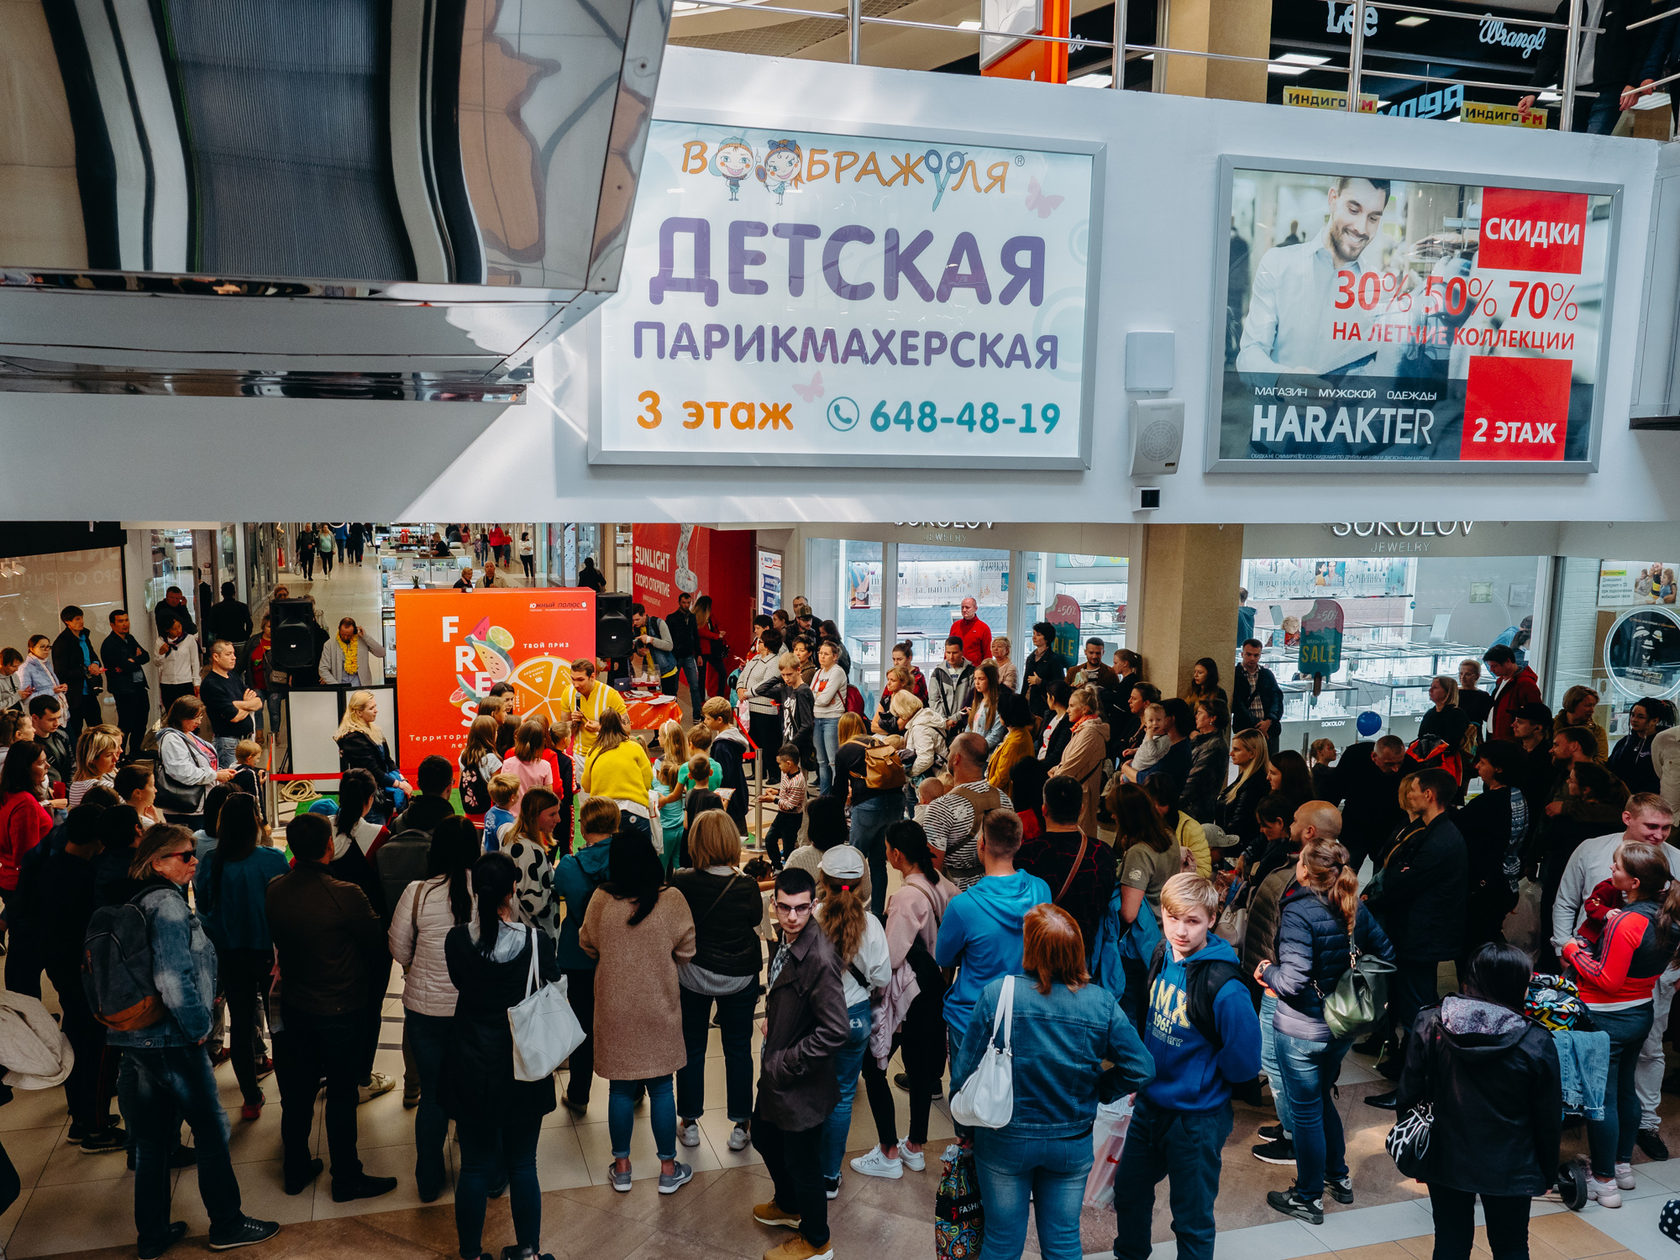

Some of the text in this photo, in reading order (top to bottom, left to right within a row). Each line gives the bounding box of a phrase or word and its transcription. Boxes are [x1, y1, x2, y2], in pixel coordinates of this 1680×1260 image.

[1327, 0, 1378, 37] Lee
[1479, 12, 1546, 59] Wrangl
[1485, 217, 1580, 248] СКИДКИ
[649, 217, 1046, 307] ДЕТСКАЯ
[1334, 270, 1579, 321] 30% 50% 70%
[633, 321, 1059, 370] ПАРИКМАХЕРСКАЯ
[1332, 321, 1575, 353] НА ЛЕТНИЕ КОЛЛЕКЦИИ
[1254, 387, 1437, 401] МАГАЗИН МУЖСКОЙ ОДЕЖДЫ
[636, 390, 1061, 434] 3 этаж 648-48-19
[1251, 405, 1435, 445] HARAKTER
[1472, 418, 1557, 445] 2 ЭТАЖ
[635, 545, 670, 573] SUNLIGHT
[1371, 541, 1431, 553] JEWELRY
[523, 641, 545, 649] ТВОЙ
[1052, 636, 1075, 657] ALE
[1301, 644, 1337, 663] SALE
